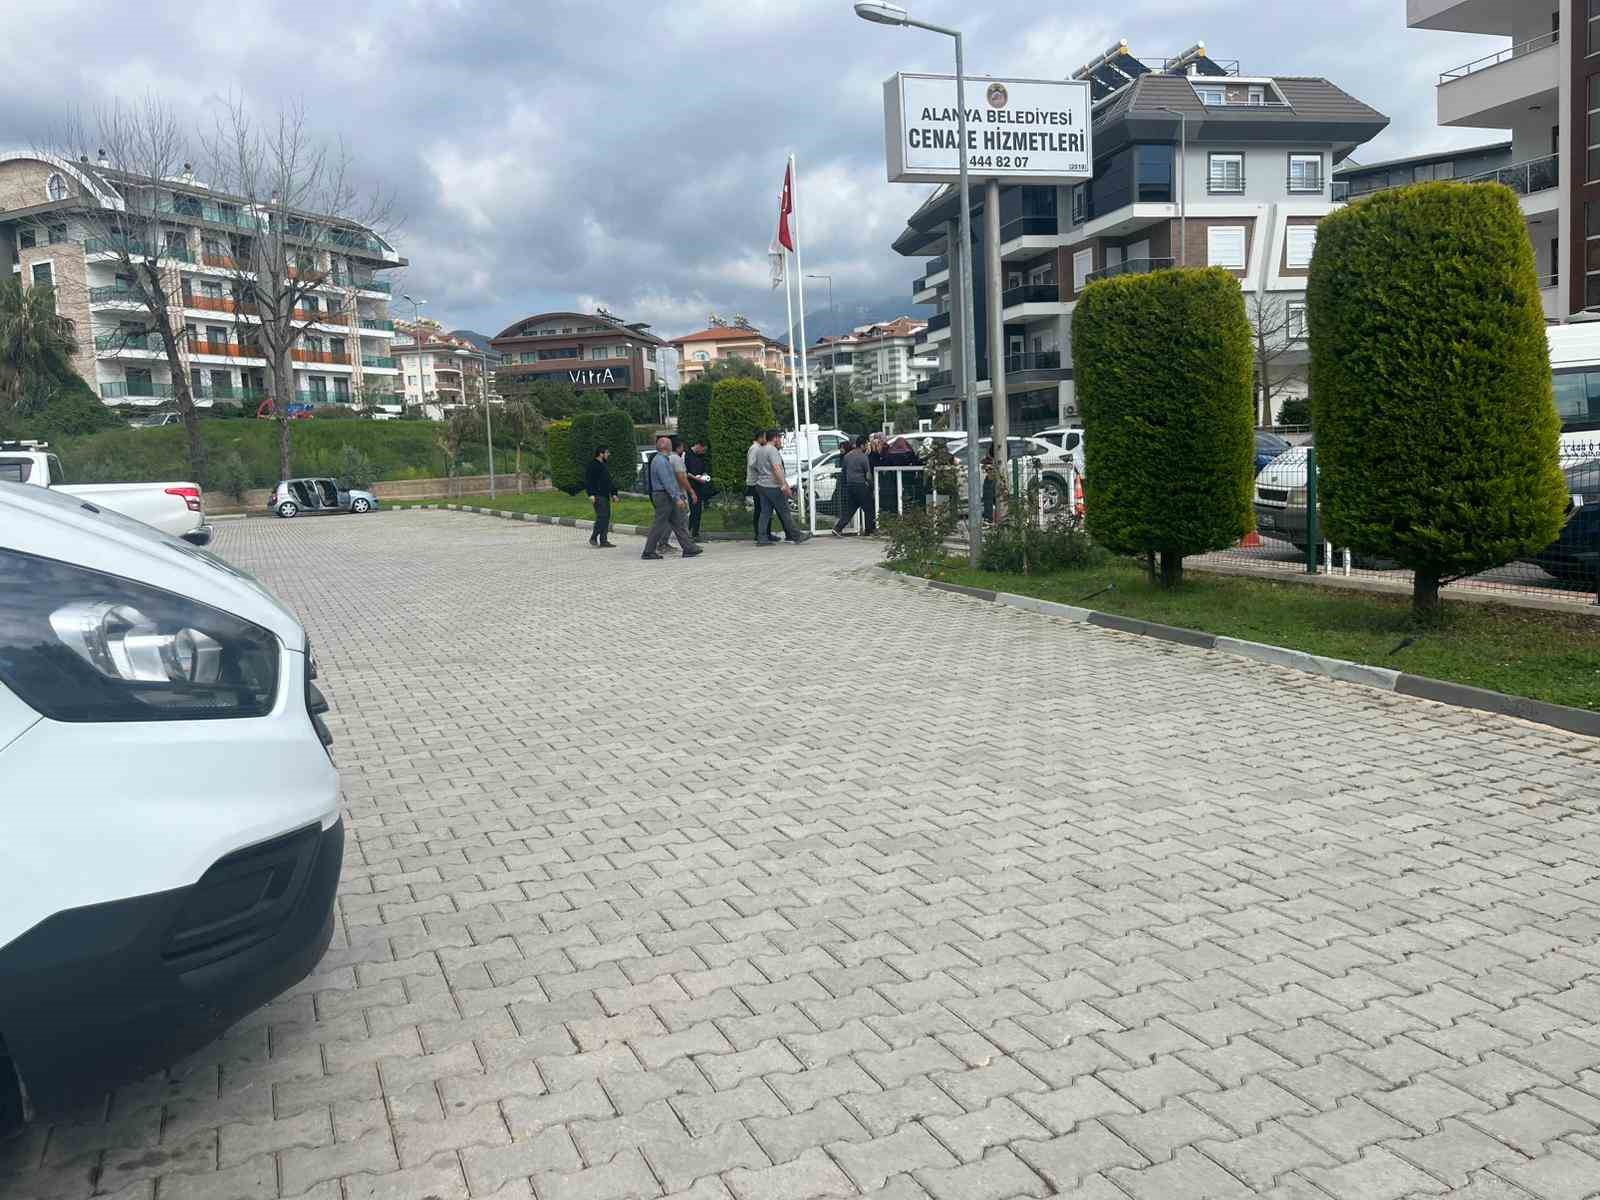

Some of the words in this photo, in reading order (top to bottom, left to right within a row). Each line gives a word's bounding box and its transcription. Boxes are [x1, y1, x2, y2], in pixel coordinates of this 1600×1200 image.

[921, 107, 982, 122] ALANYA
[986, 107, 1072, 126] BELEDİYESİ
[983, 126, 1085, 152] HİZMETLERİ
[969, 155, 992, 167] 444
[996, 156, 1011, 168] 82
[1014, 156, 1029, 168] 07
